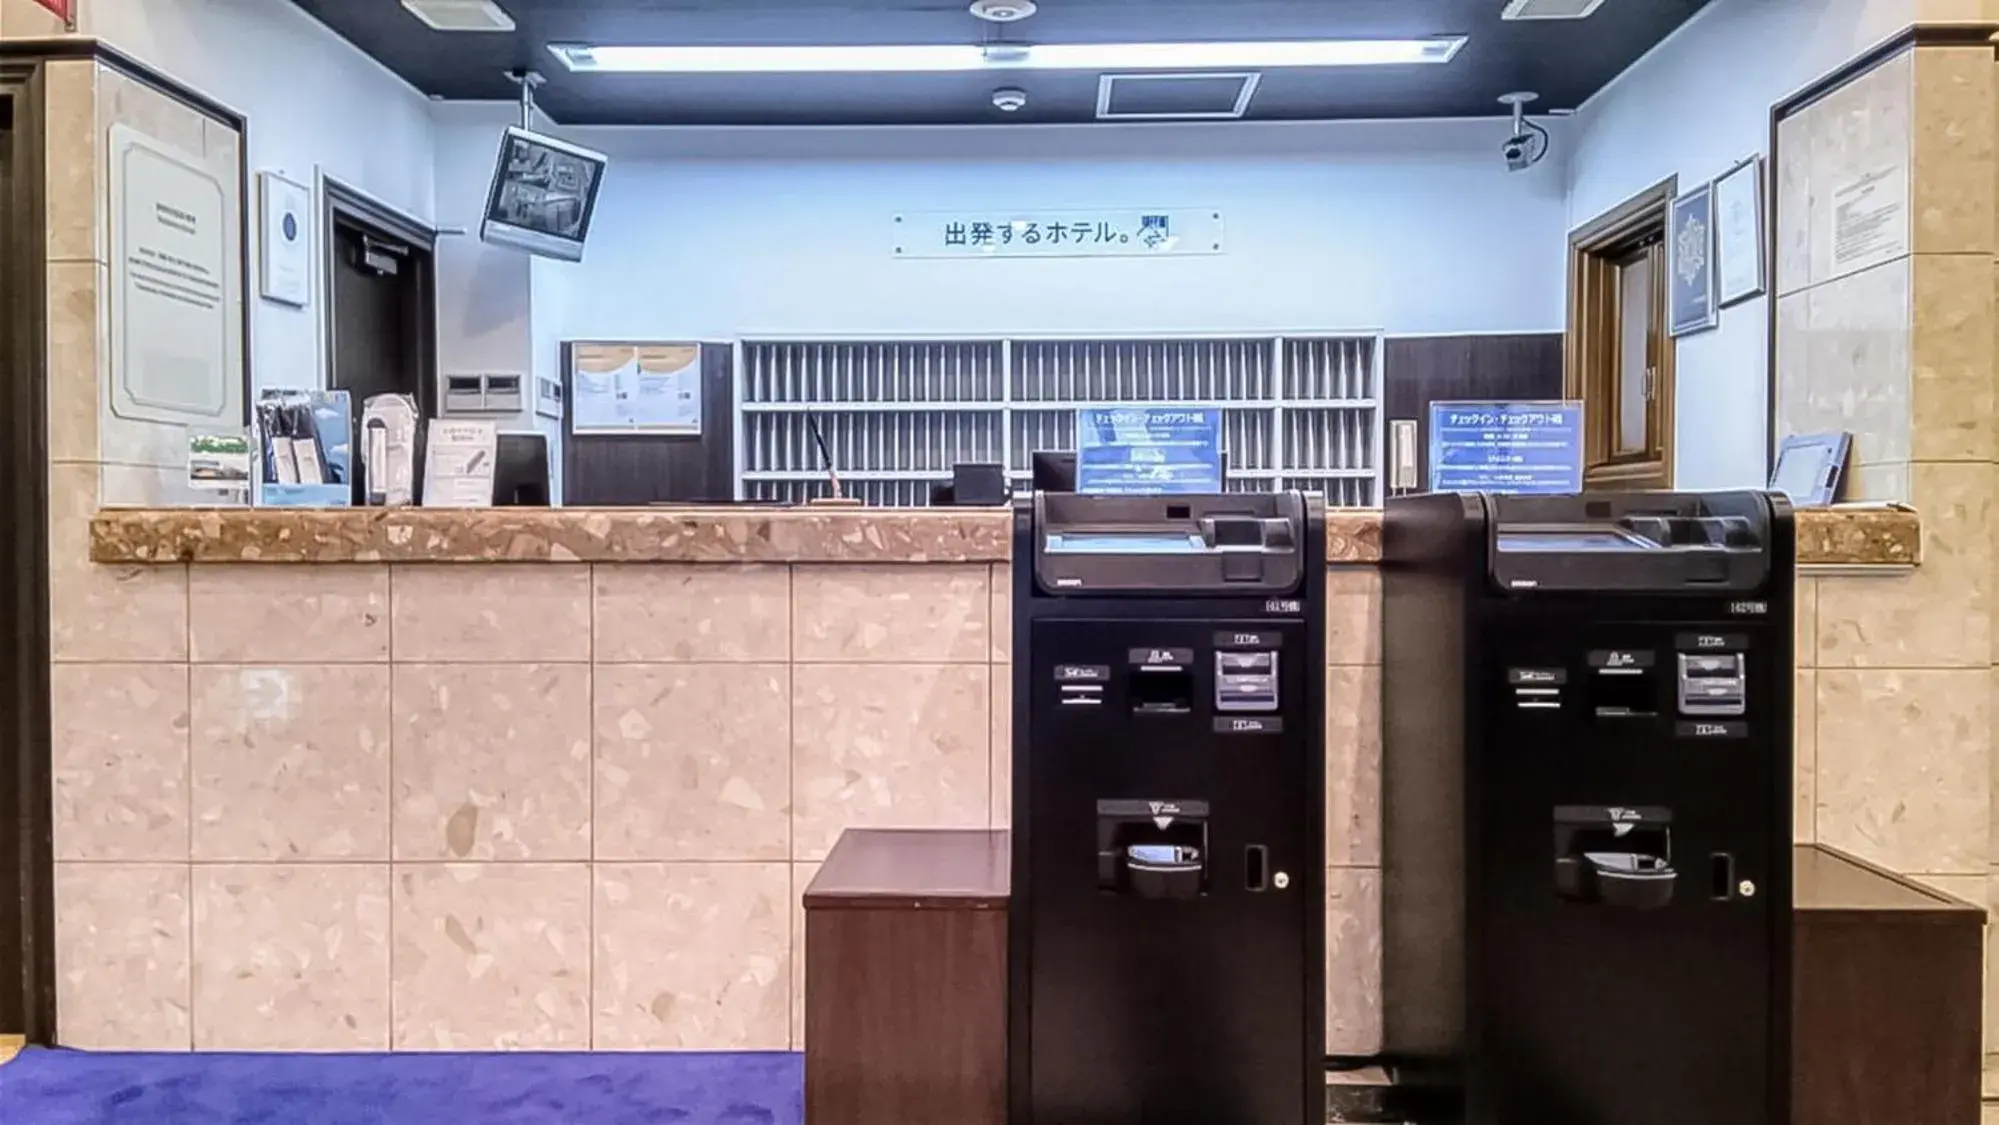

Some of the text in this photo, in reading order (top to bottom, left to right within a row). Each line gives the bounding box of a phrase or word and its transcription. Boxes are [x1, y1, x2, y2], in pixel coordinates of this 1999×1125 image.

[945, 221, 1129, 246] 出発するホテル。
